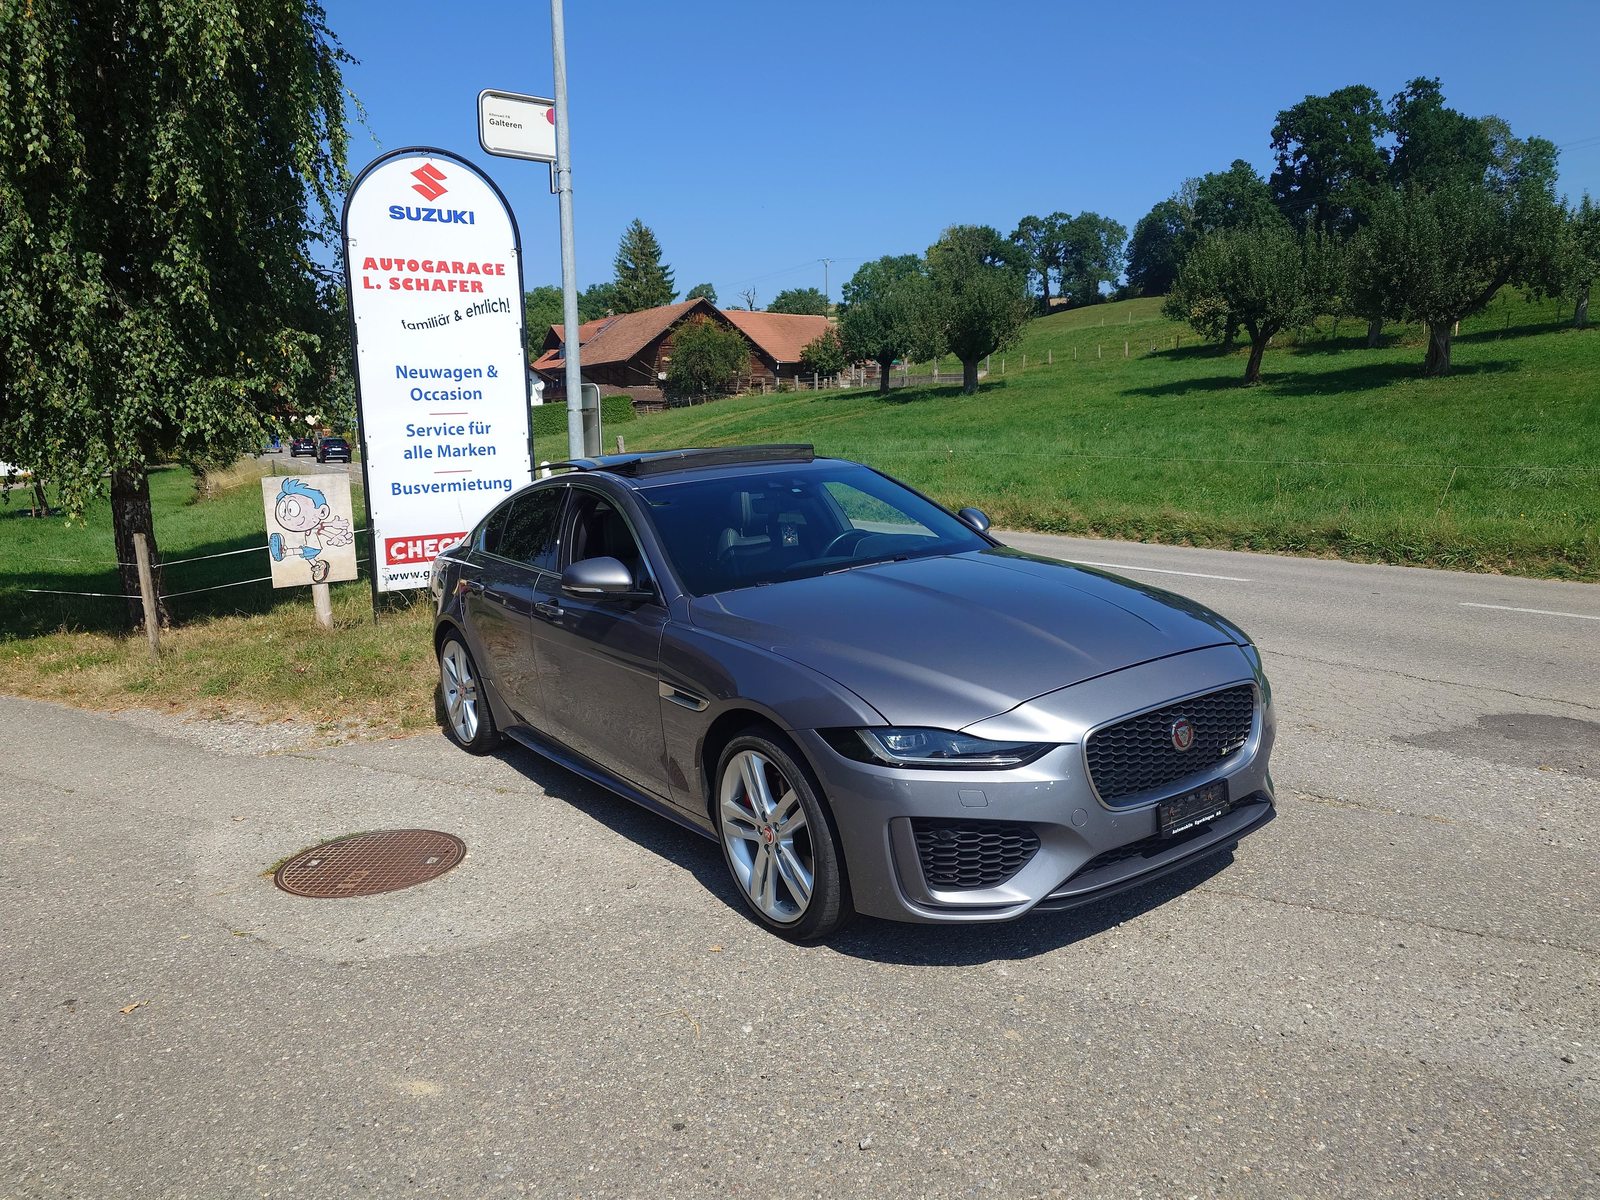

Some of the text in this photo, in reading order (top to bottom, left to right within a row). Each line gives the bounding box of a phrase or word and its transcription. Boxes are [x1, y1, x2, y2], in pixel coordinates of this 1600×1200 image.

[488, 118, 523, 130] Galteren
[388, 205, 475, 225] SUZUKI
[362, 257, 506, 276] AUTOGARAGE
[362, 276, 484, 293] L. SCHAFER
[401, 297, 511, 330] familiär & ehrlich!
[395, 364, 498, 382] Neuwagen &
[410, 387, 483, 401] Occasion
[405, 421, 491, 437] Service für
[403, 443, 496, 460] alle Marken
[391, 477, 513, 496] Busvermietung
[390, 537, 466, 560] CHEC
[388, 570, 430, 581] www.g
